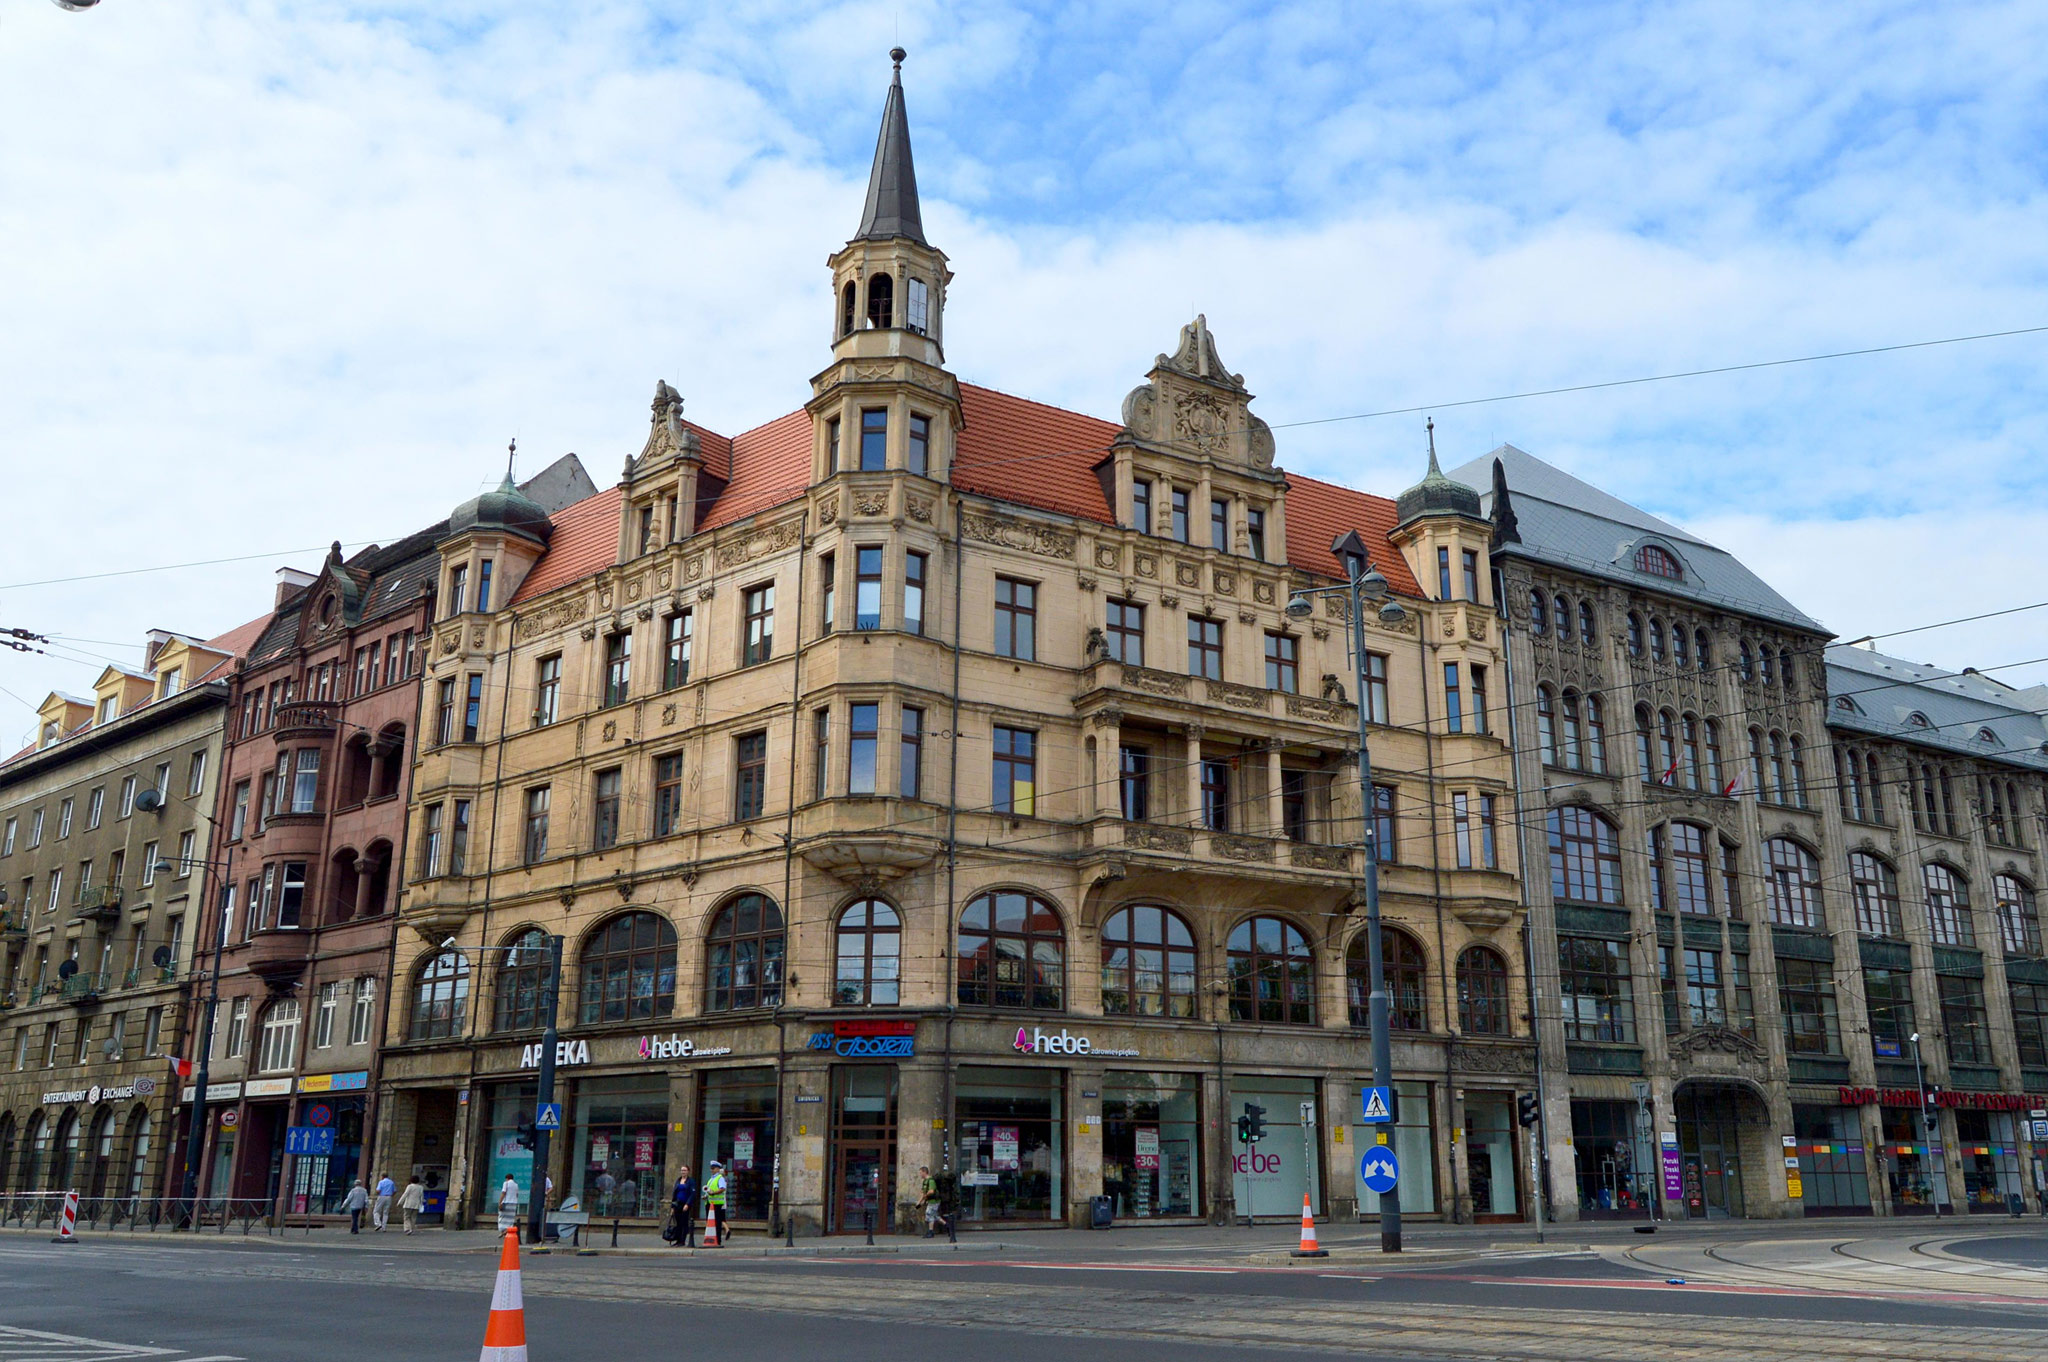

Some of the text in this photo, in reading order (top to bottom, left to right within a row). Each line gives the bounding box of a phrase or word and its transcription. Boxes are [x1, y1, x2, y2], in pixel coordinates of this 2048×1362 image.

[651, 1033, 694, 1059] hebe
[806, 1033, 835, 1049] PSS
[1033, 1027, 1091, 1055] hebe
[520, 1039, 591, 1069] APEKA
[42, 1090, 87, 1104] ENTERTAINMENT
[102, 1086, 134, 1099] EXCHANGE
[1839, 1087, 1878, 1104] DOM
